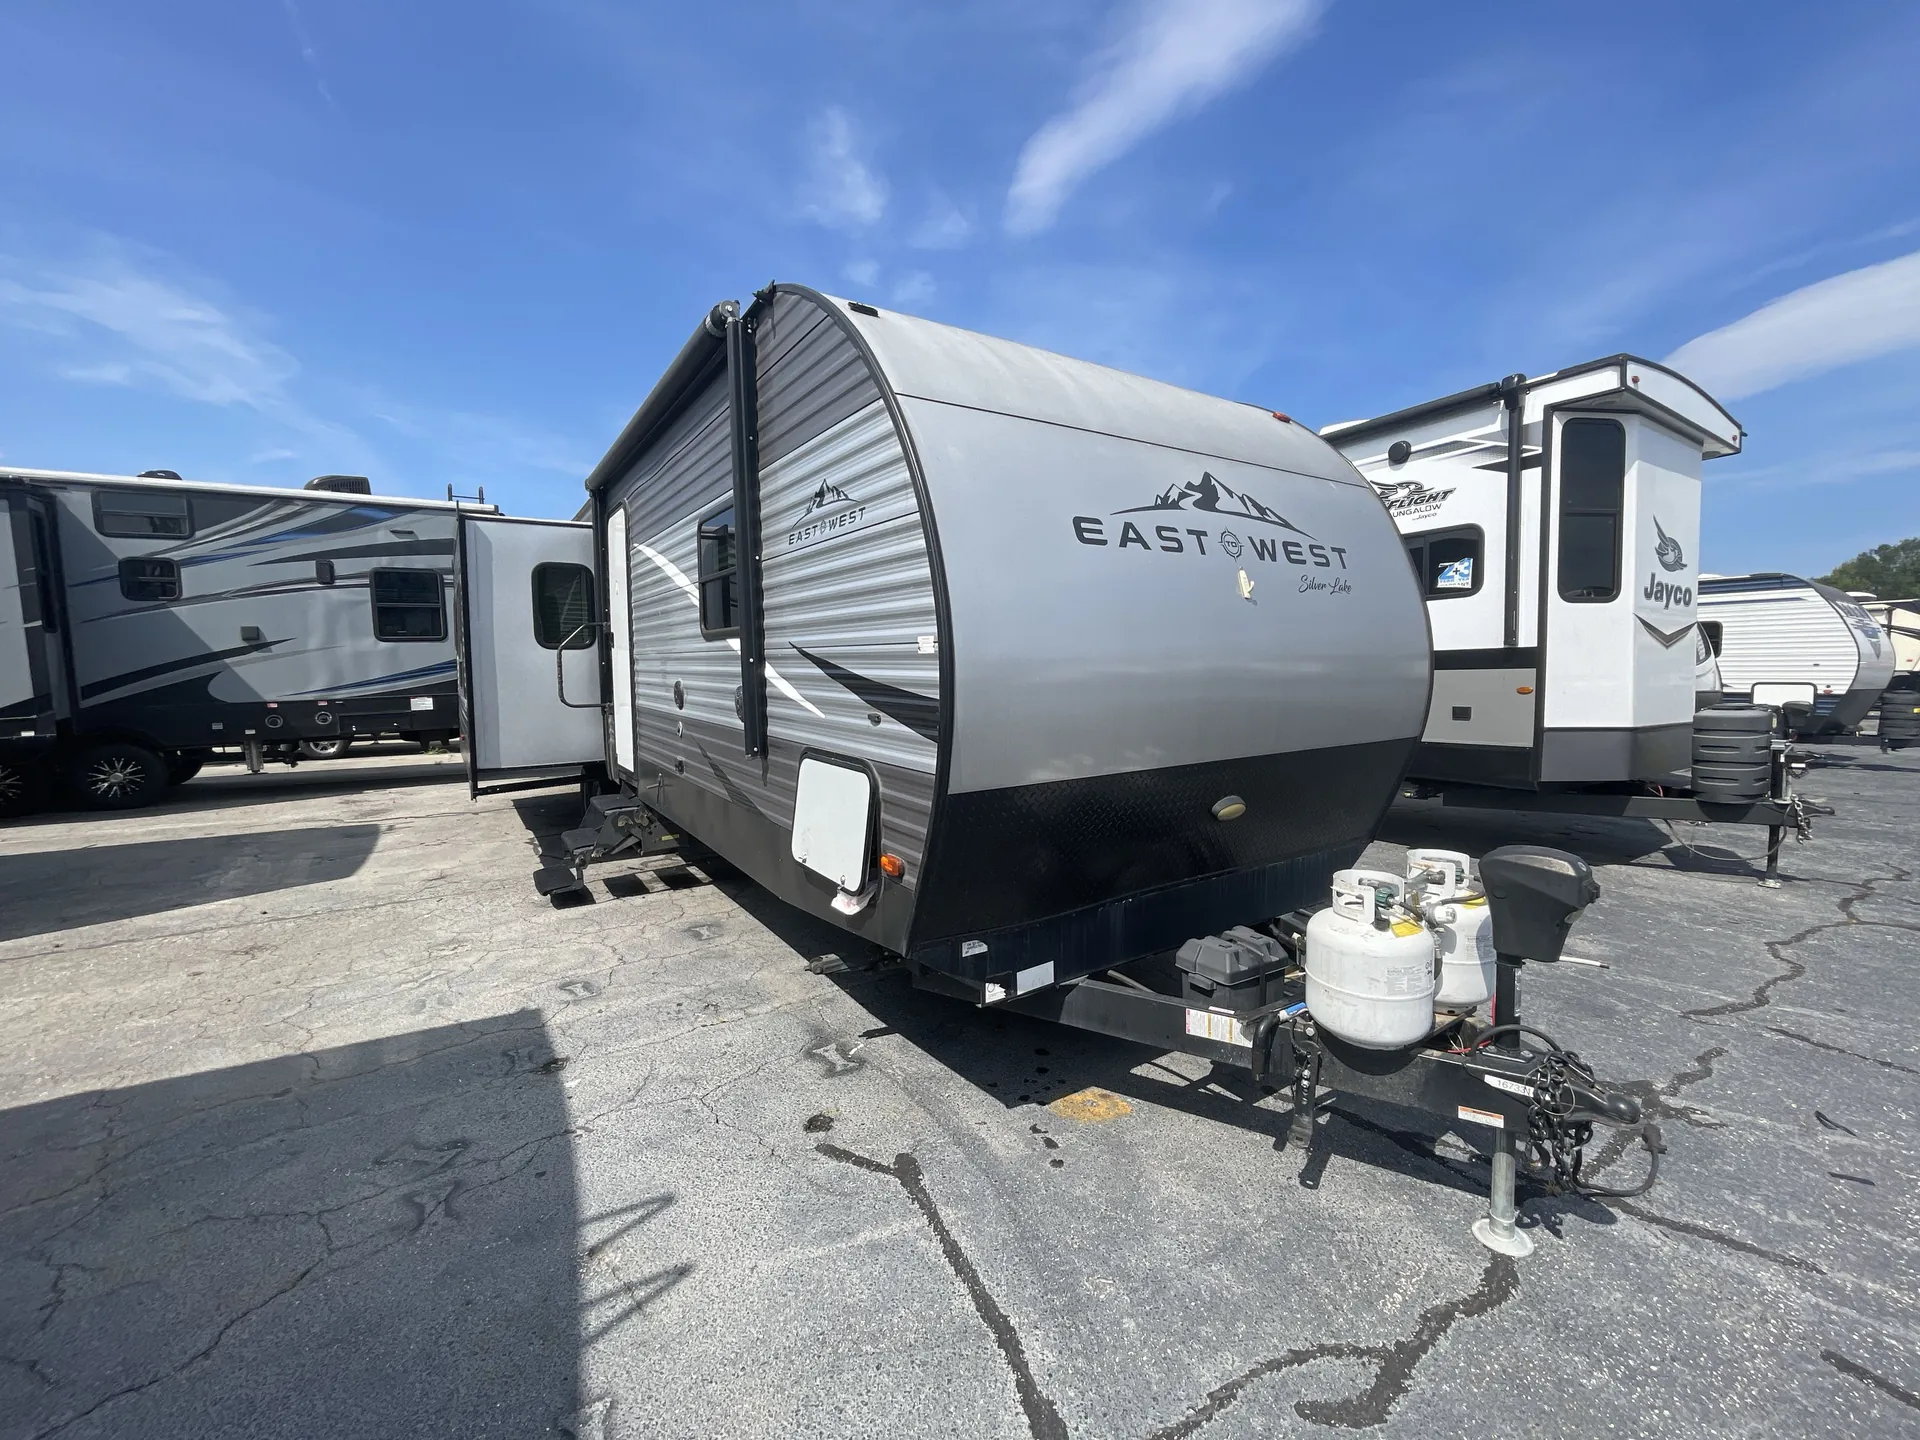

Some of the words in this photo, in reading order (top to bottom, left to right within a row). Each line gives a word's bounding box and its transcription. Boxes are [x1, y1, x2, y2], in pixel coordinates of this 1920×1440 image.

[1387, 487, 1457, 510] FLIGHT
[1392, 503, 1443, 518] UNGALOW
[788, 524, 819, 546] EAST
[828, 506, 867, 532] WEST
[1072, 515, 1209, 556] EAST
[1225, 540, 1238, 548] TO
[1247, 536, 1348, 570] WEST
[1298, 574, 1327, 594] Silver
[1328, 577, 1353, 595] Lake
[1643, 571, 1693, 610] Jayco
